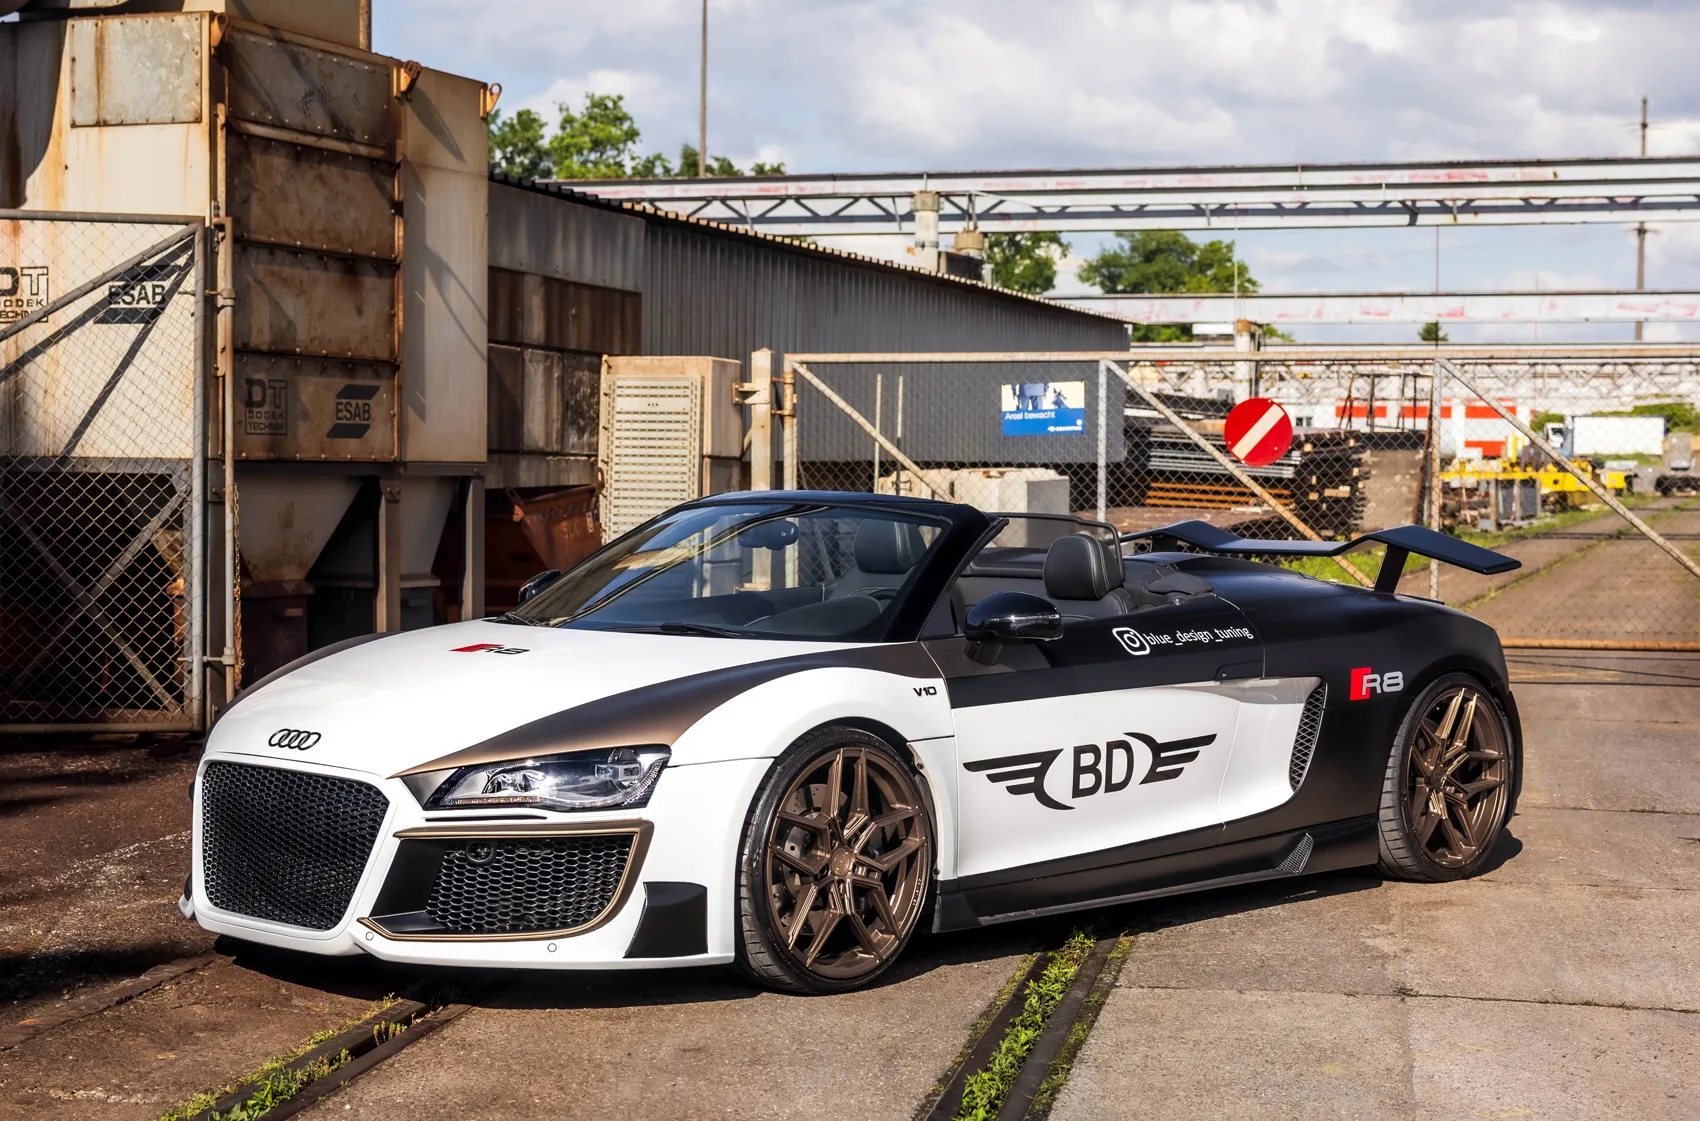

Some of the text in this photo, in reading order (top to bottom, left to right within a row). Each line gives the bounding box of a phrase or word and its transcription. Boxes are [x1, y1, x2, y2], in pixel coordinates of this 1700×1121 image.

[3, 299, 44, 307] ODEK
[108, 284, 166, 305] ESAB
[245, 378, 287, 409] DT
[248, 410, 284, 420] DODEK
[335, 402, 371, 421] ESAB
[1143, 626, 1254, 646] blue_design_tuning
[913, 686, 937, 697] V10
[1360, 671, 1404, 696] R8
[1071, 739, 1135, 799] BD
